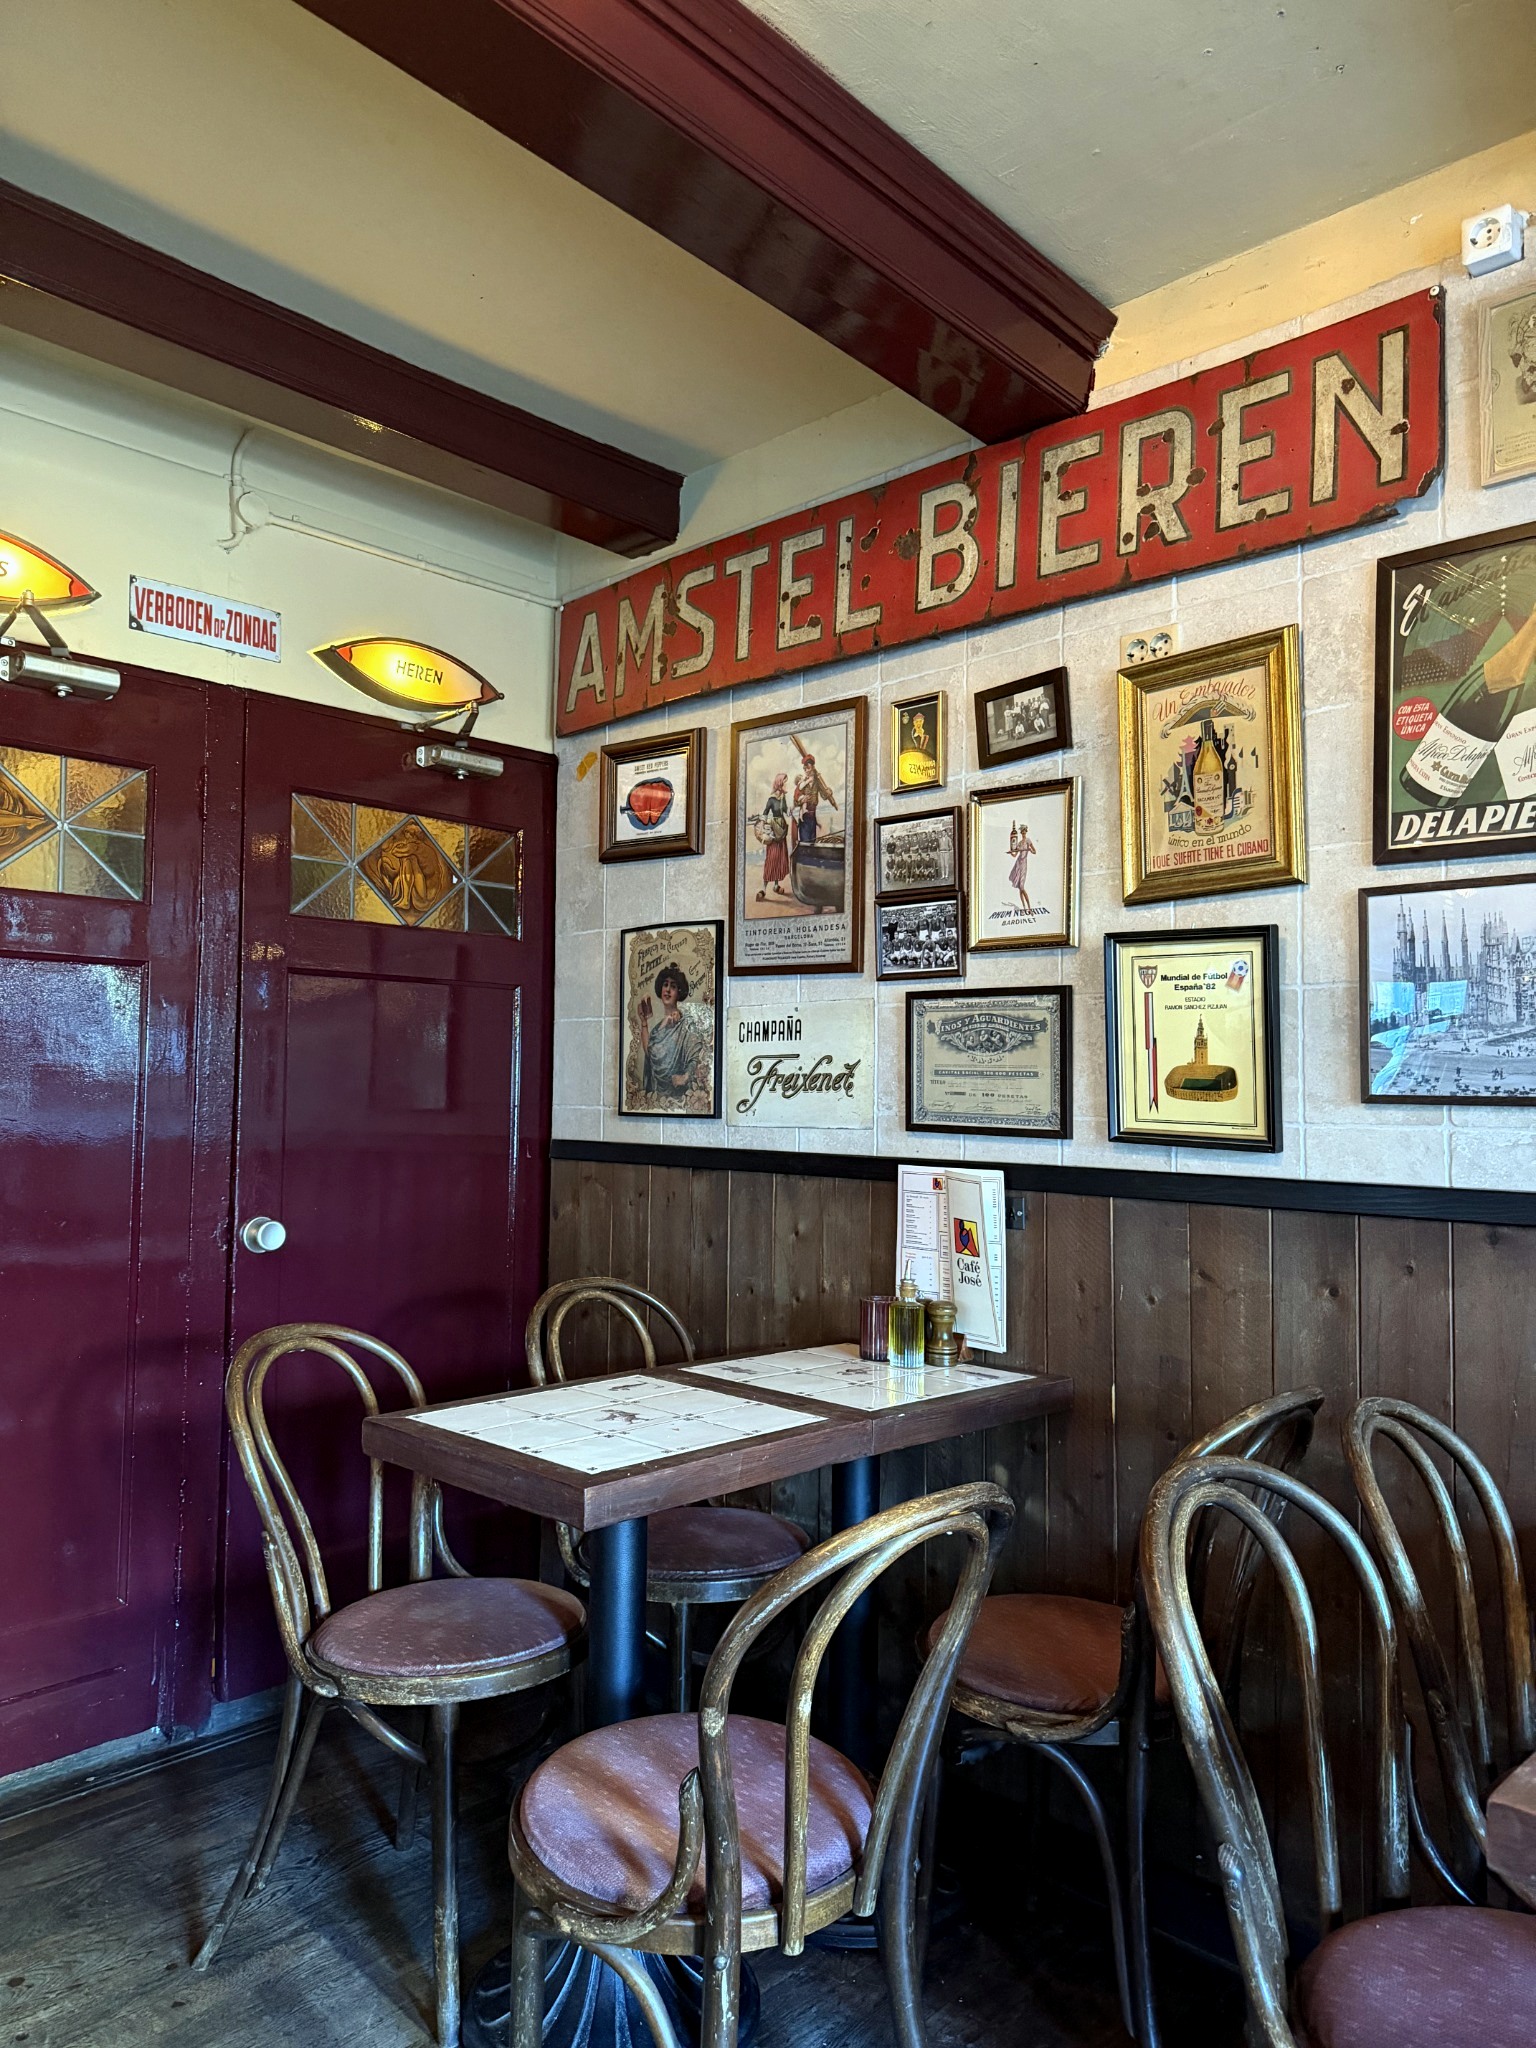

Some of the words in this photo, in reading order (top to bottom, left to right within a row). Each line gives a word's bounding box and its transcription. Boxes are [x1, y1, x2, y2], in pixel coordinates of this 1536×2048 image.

[565, 515, 882, 714] AMSTEL
[917, 325, 1409, 613] BIEREN
[134, 585, 213, 637] VERBODEN
[213, 617, 226, 639] OP
[226, 608, 277, 653] ZONDAG
[396, 660, 444, 686] HEREN
[1179, 678, 1257, 706] Embajador
[1398, 706, 1414, 715] CON
[1412, 702, 1430, 712] ESTA
[1396, 712, 1433, 726] ETIQUETA
[1400, 723, 1426, 735] ÚNICA
[1168, 834, 1189, 848] único
[1192, 839, 1204, 848] en
[1206, 836, 1215, 846] el
[1217, 824, 1252, 844] mundo
[1173, 848, 1201, 866] SUERTE
[1203, 845, 1223, 861] TIENE
[1226, 843, 1235, 857] EL
[1237, 838, 1269, 857] CUBANO
[745, 927, 790, 936] TINTORERIA
[796, 923, 846, 932] HOLANDESA
[1001, 918, 1036, 926] BARDINET
[1160, 974, 1190, 982] Mundial
[1203, 972, 1228, 980] Fútbol
[1174, 983, 1203, 992] España
[738, 1015, 802, 1043] CHAMPAÑA
[972, 1014, 1041, 1031] AGUARDIENTES
[736, 1053, 860, 1113] Freixenet
[957, 1258, 980, 1274] Café
[958, 1271, 982, 1287] José
